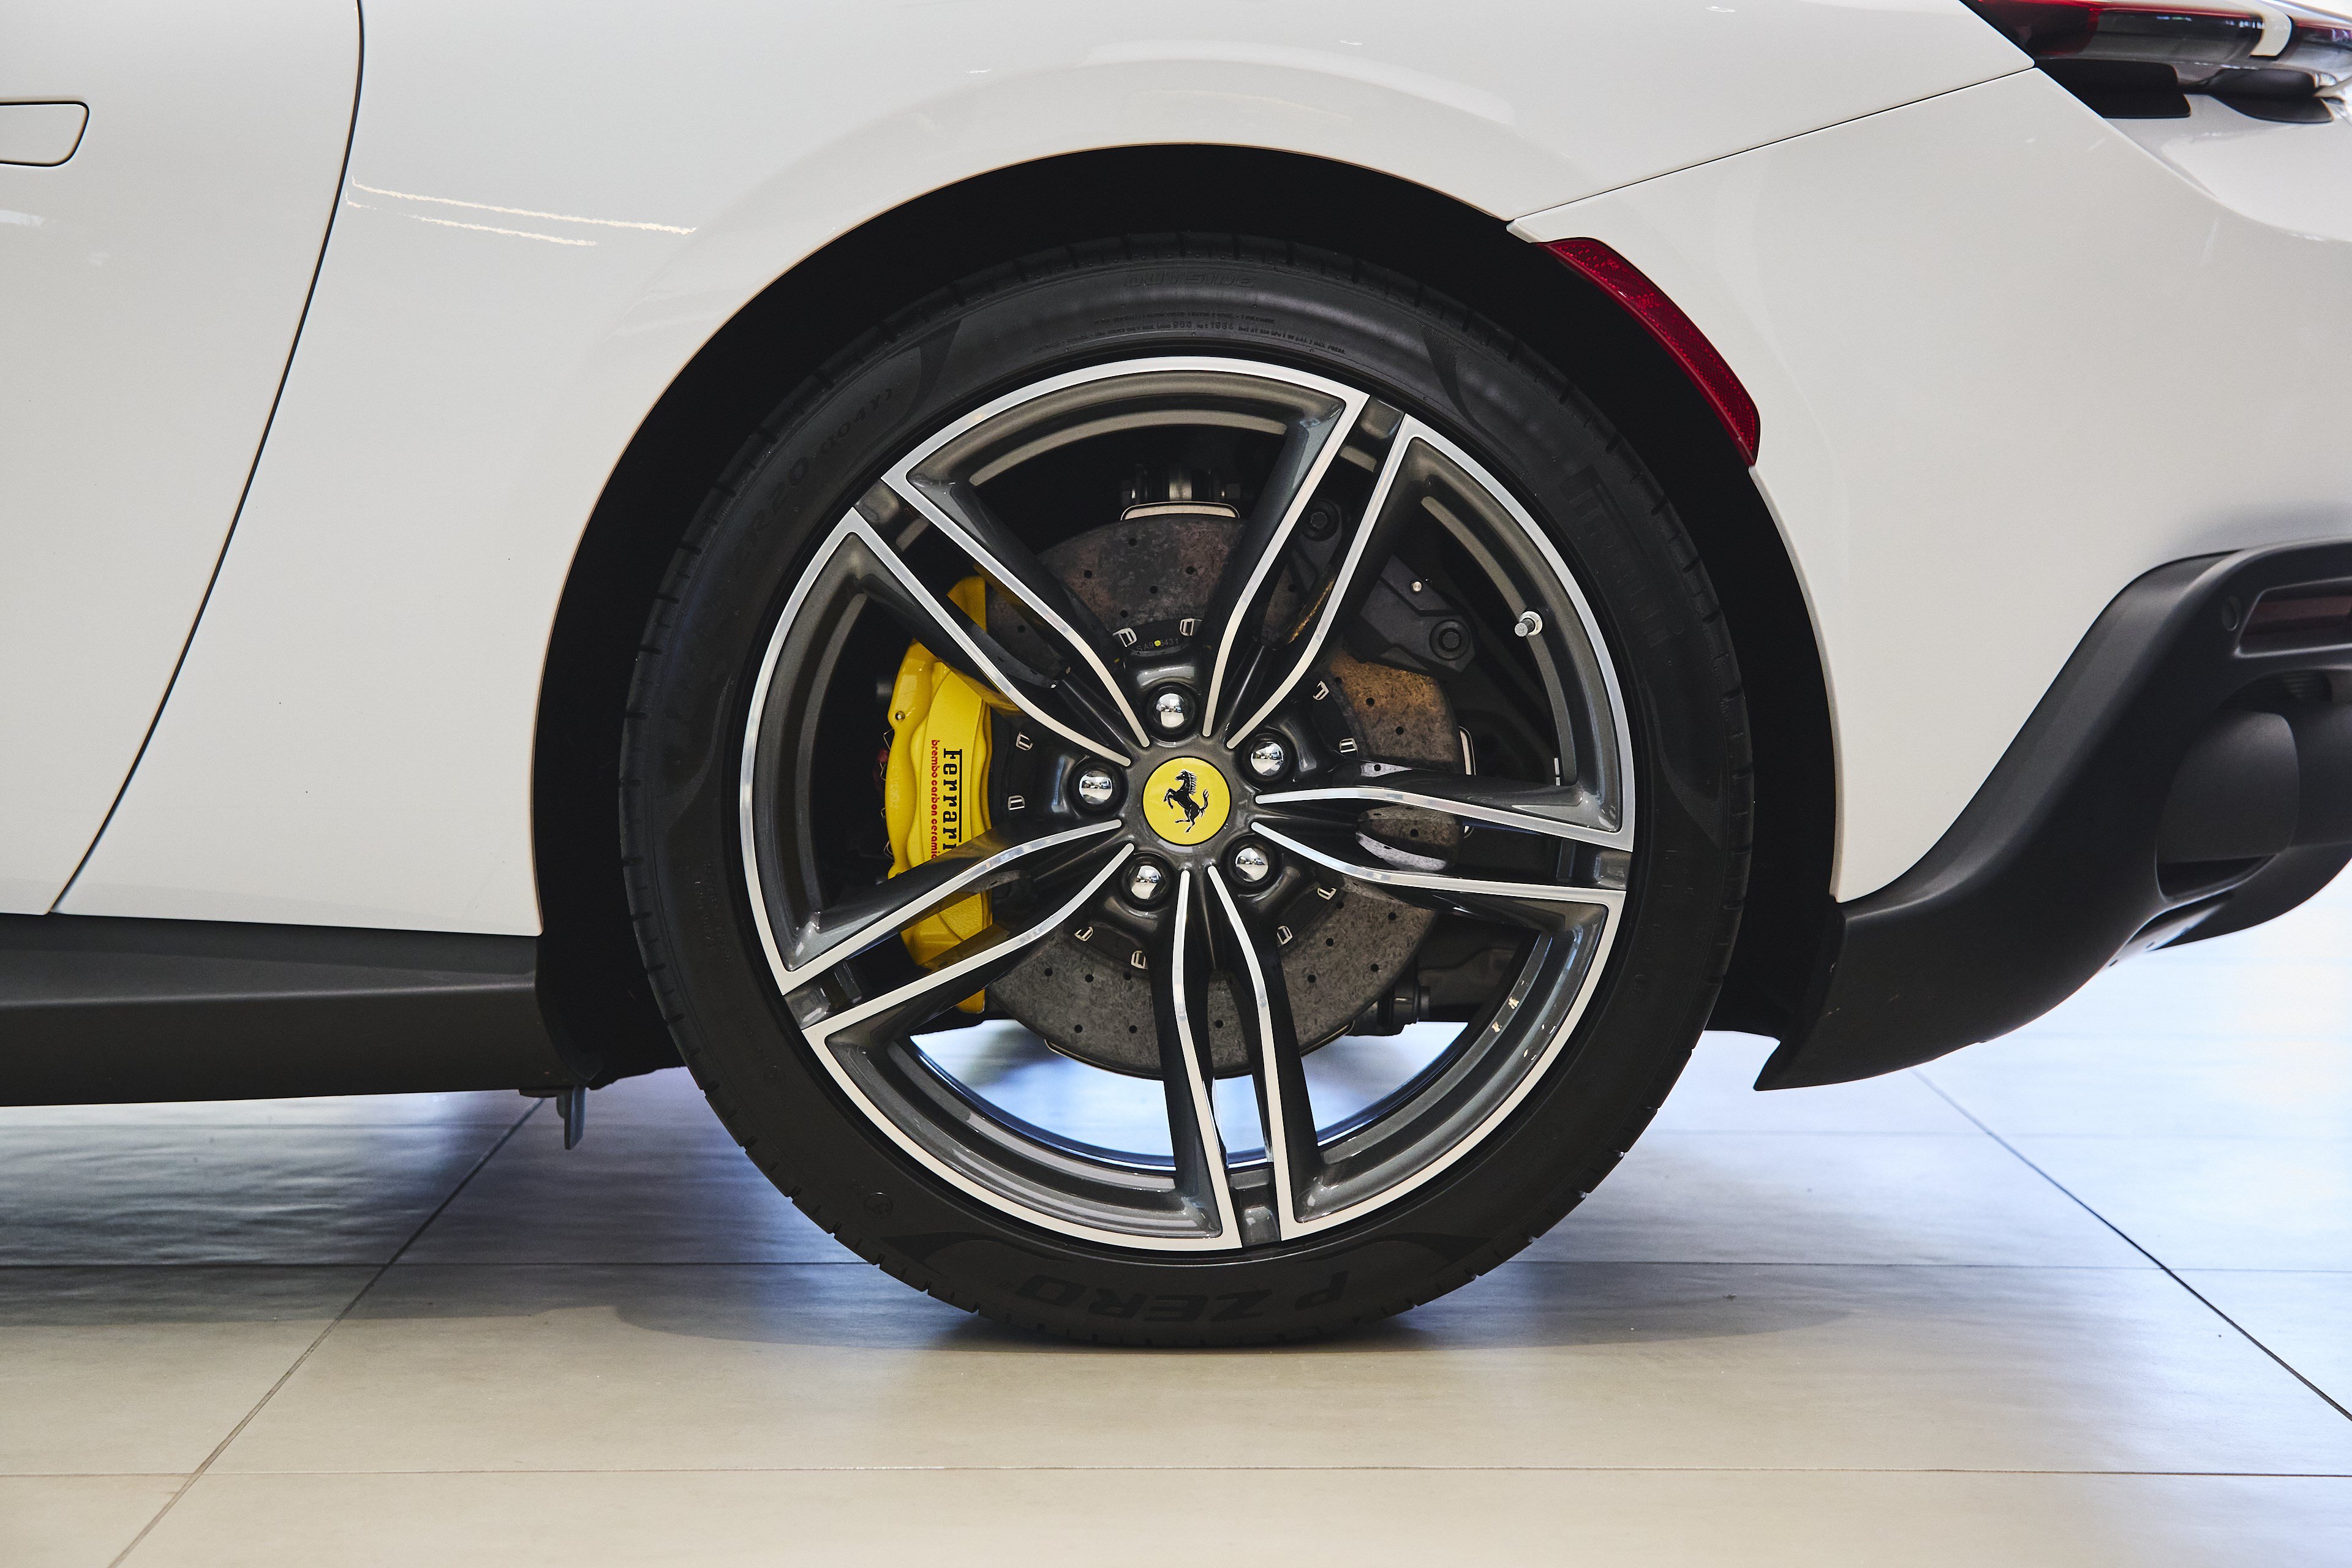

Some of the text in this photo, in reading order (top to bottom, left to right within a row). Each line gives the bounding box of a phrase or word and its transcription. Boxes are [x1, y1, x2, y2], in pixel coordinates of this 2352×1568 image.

[931, 739, 940, 778] brembo
[931, 780, 940, 816] carbon
[943, 748, 962, 850] Ferrari
[1014, 1270, 1348, 1323] P ZERO
